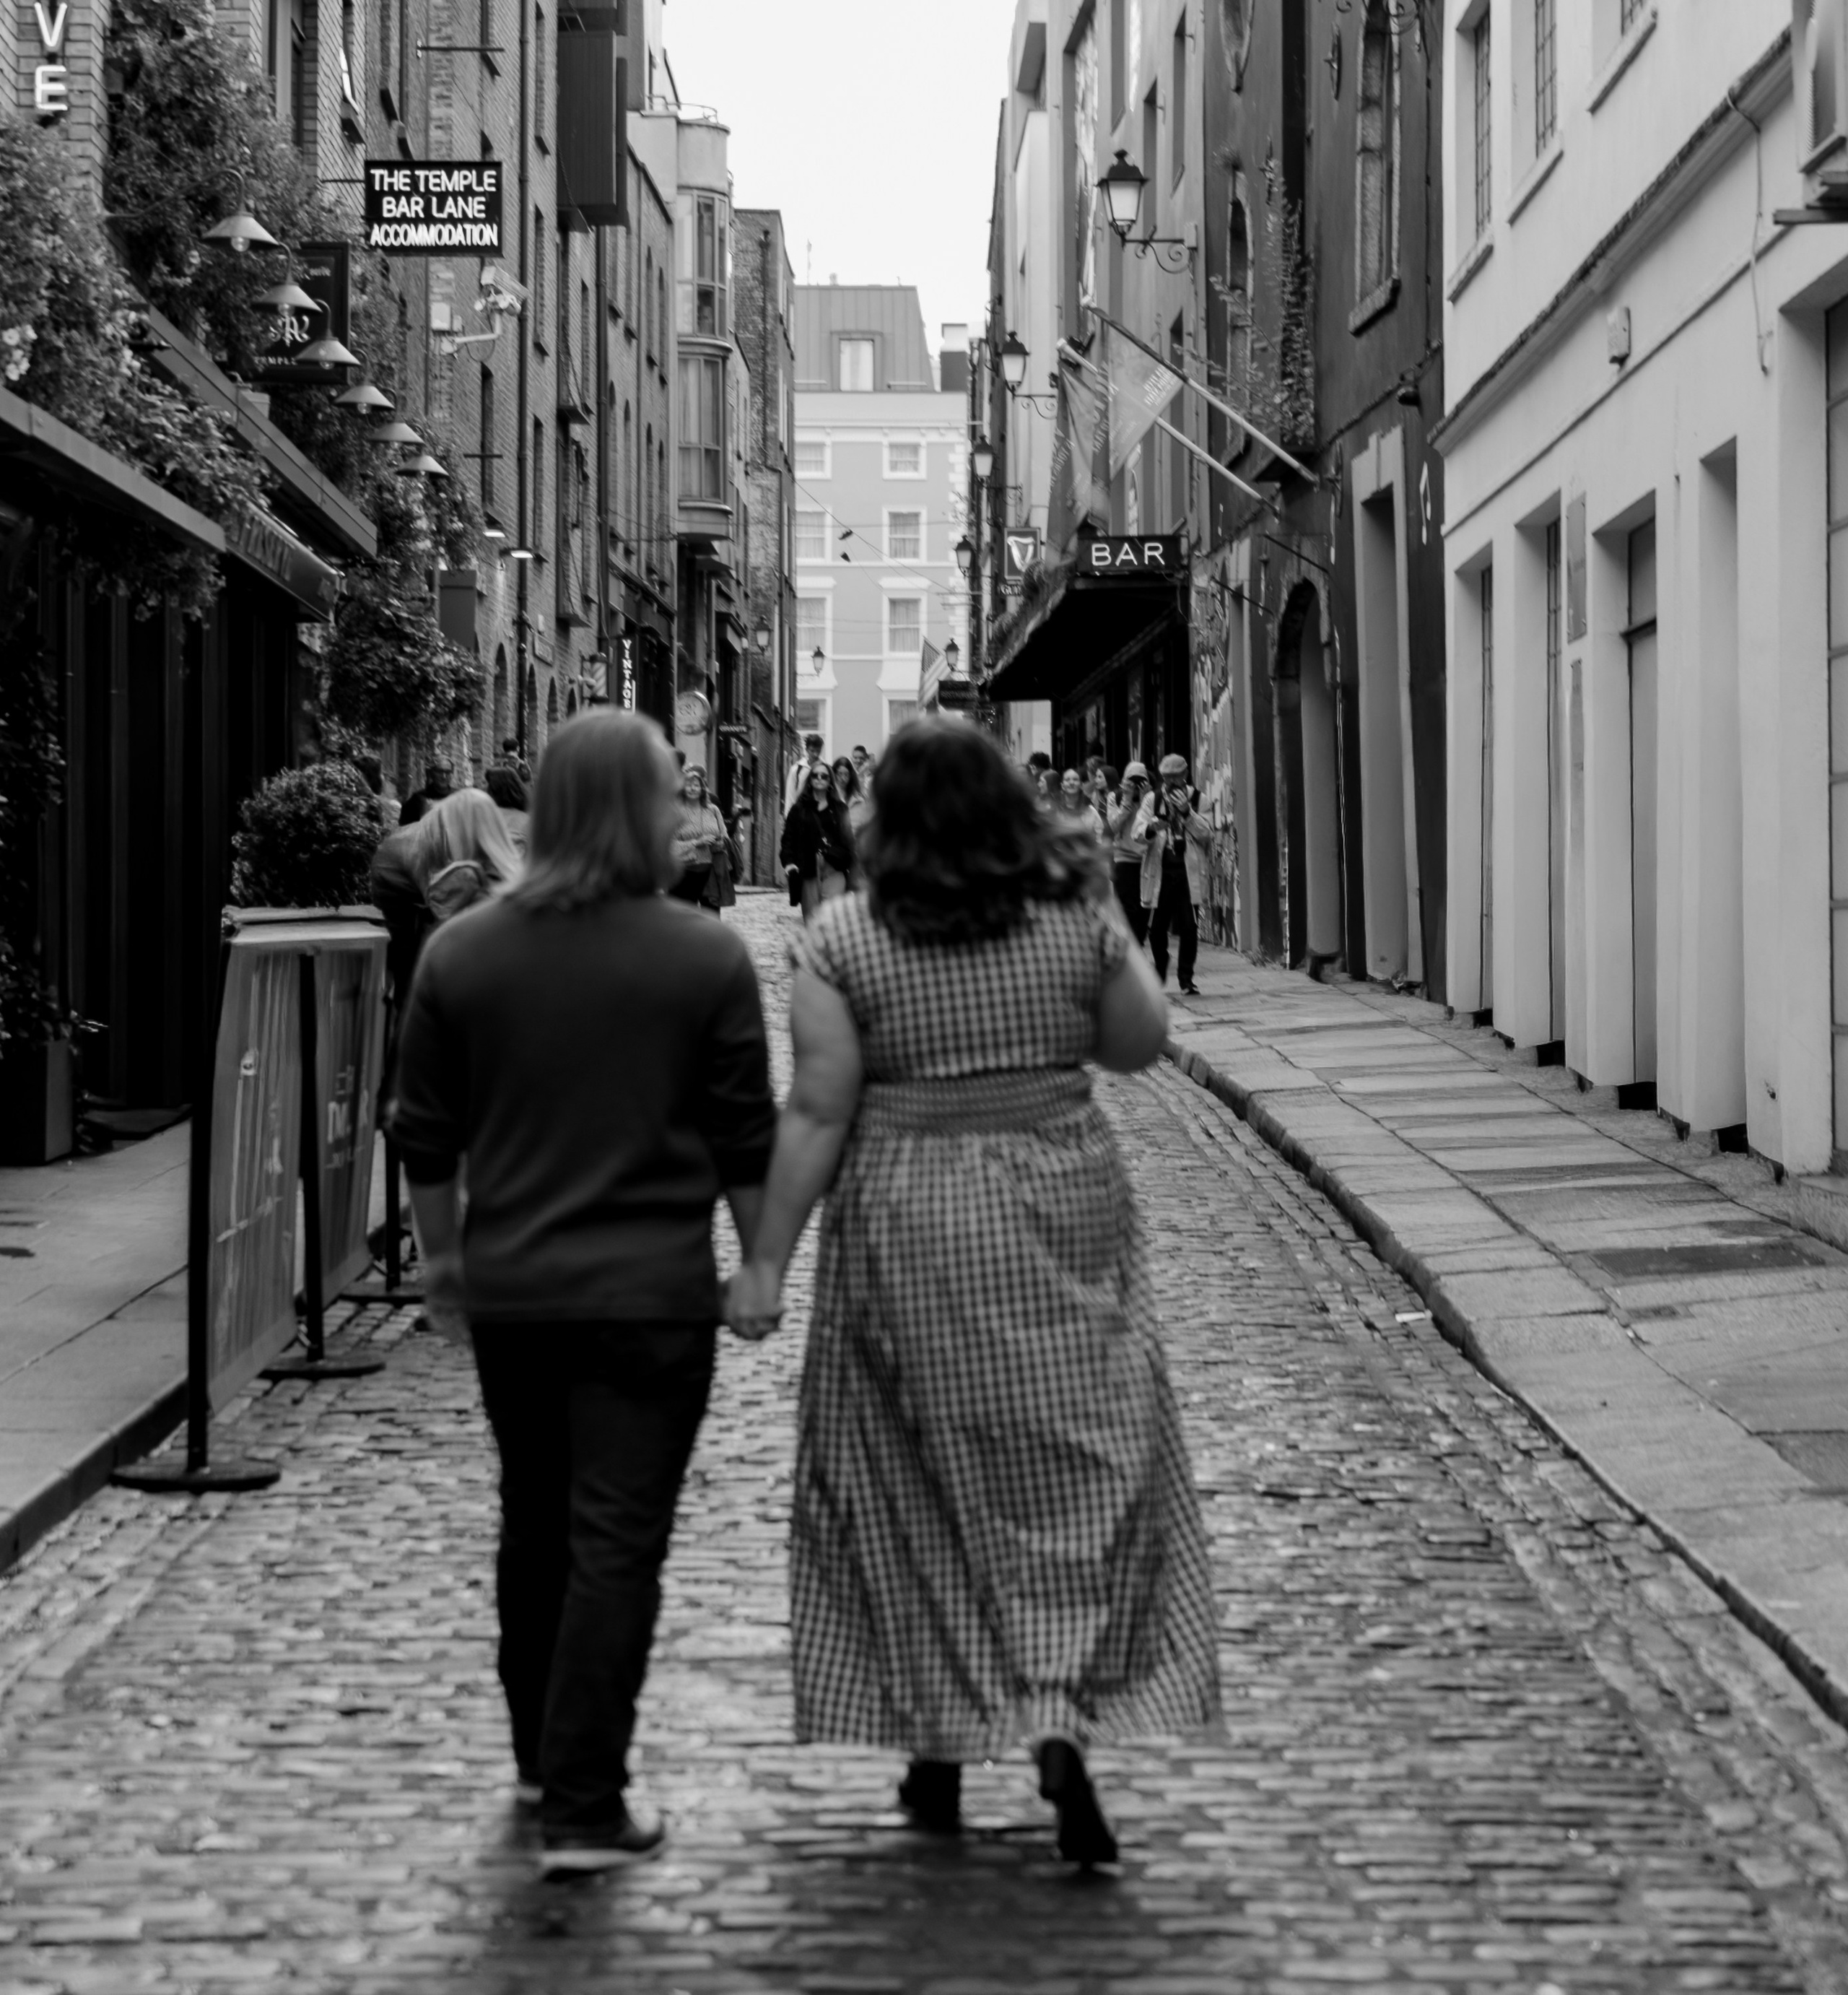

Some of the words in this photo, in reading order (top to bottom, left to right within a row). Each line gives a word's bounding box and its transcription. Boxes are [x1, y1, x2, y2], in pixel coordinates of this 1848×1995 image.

[370, 169, 411, 191] THE
[414, 170, 497, 192] TEMPLE
[383, 196, 425, 218] BAR
[432, 196, 487, 219] LANE
[370, 223, 499, 247] ACCOMMODATION
[1091, 542, 1165, 566] BAR
[622, 638, 633, 709] VINTAGE
